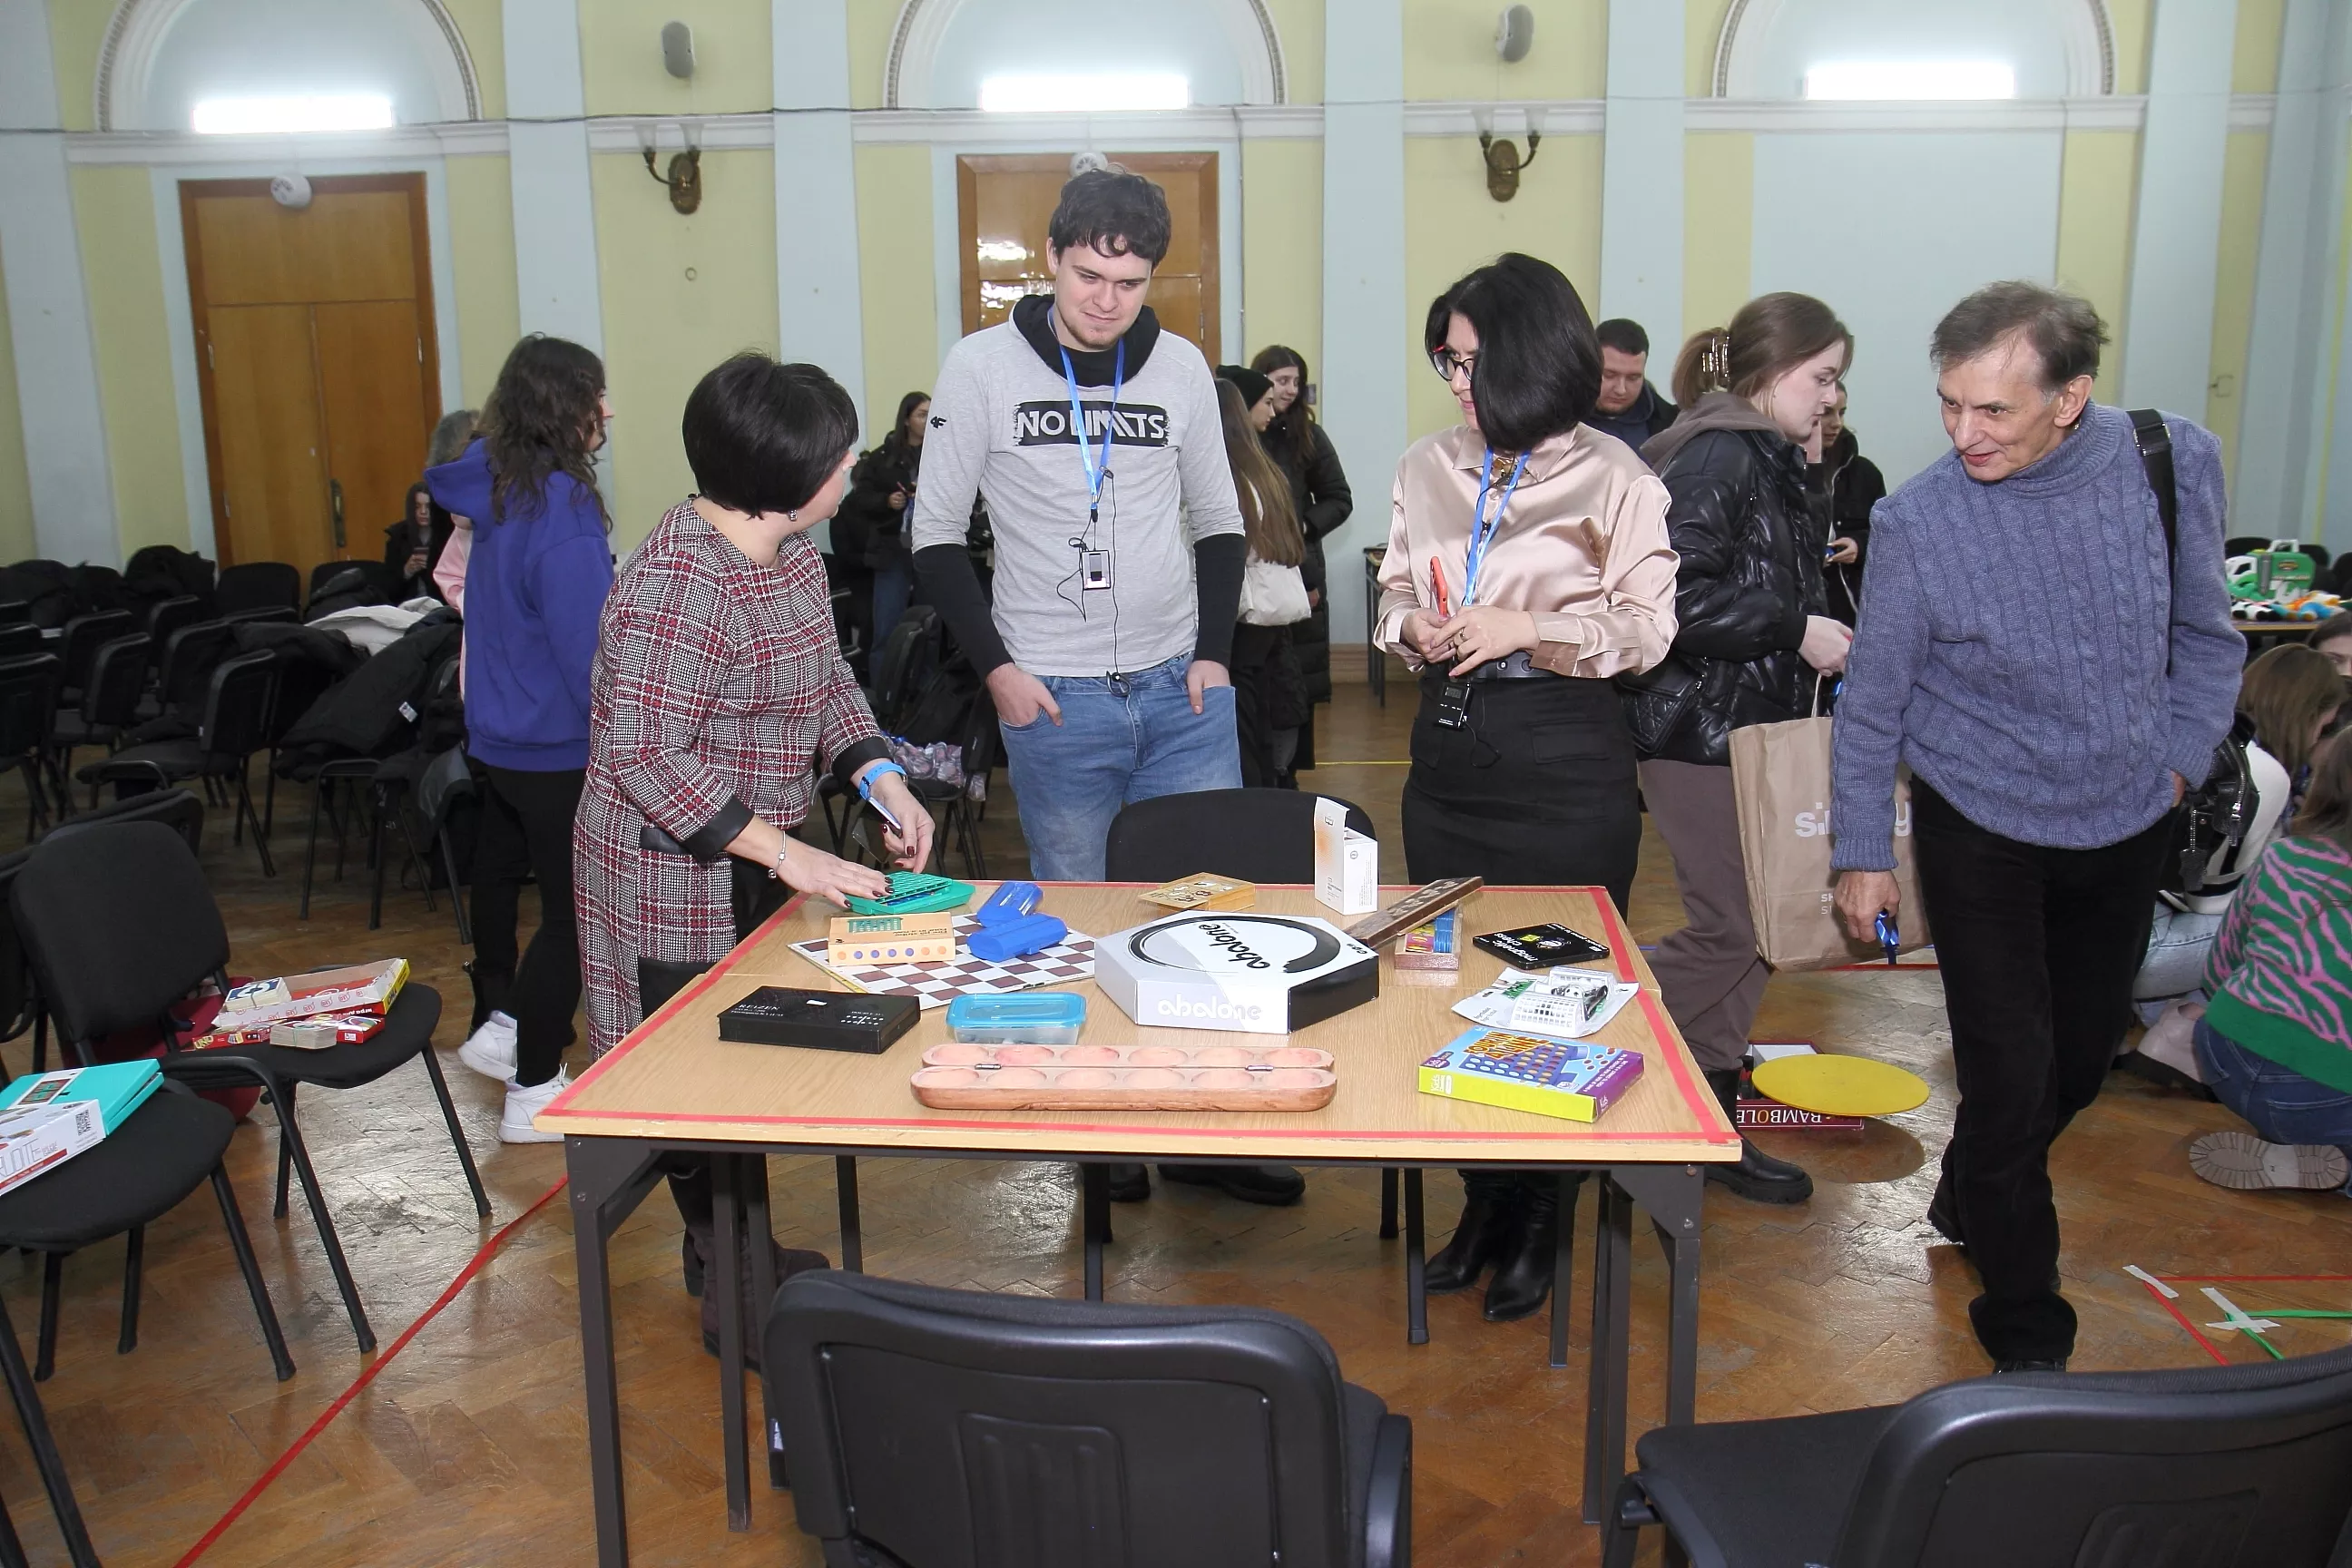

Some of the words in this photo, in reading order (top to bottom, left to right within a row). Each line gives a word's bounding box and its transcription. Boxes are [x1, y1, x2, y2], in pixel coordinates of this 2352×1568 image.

[1016, 409, 1065, 437] NO
[1198, 923, 1271, 969] abalone
[1157, 993, 1262, 1021] abalone
